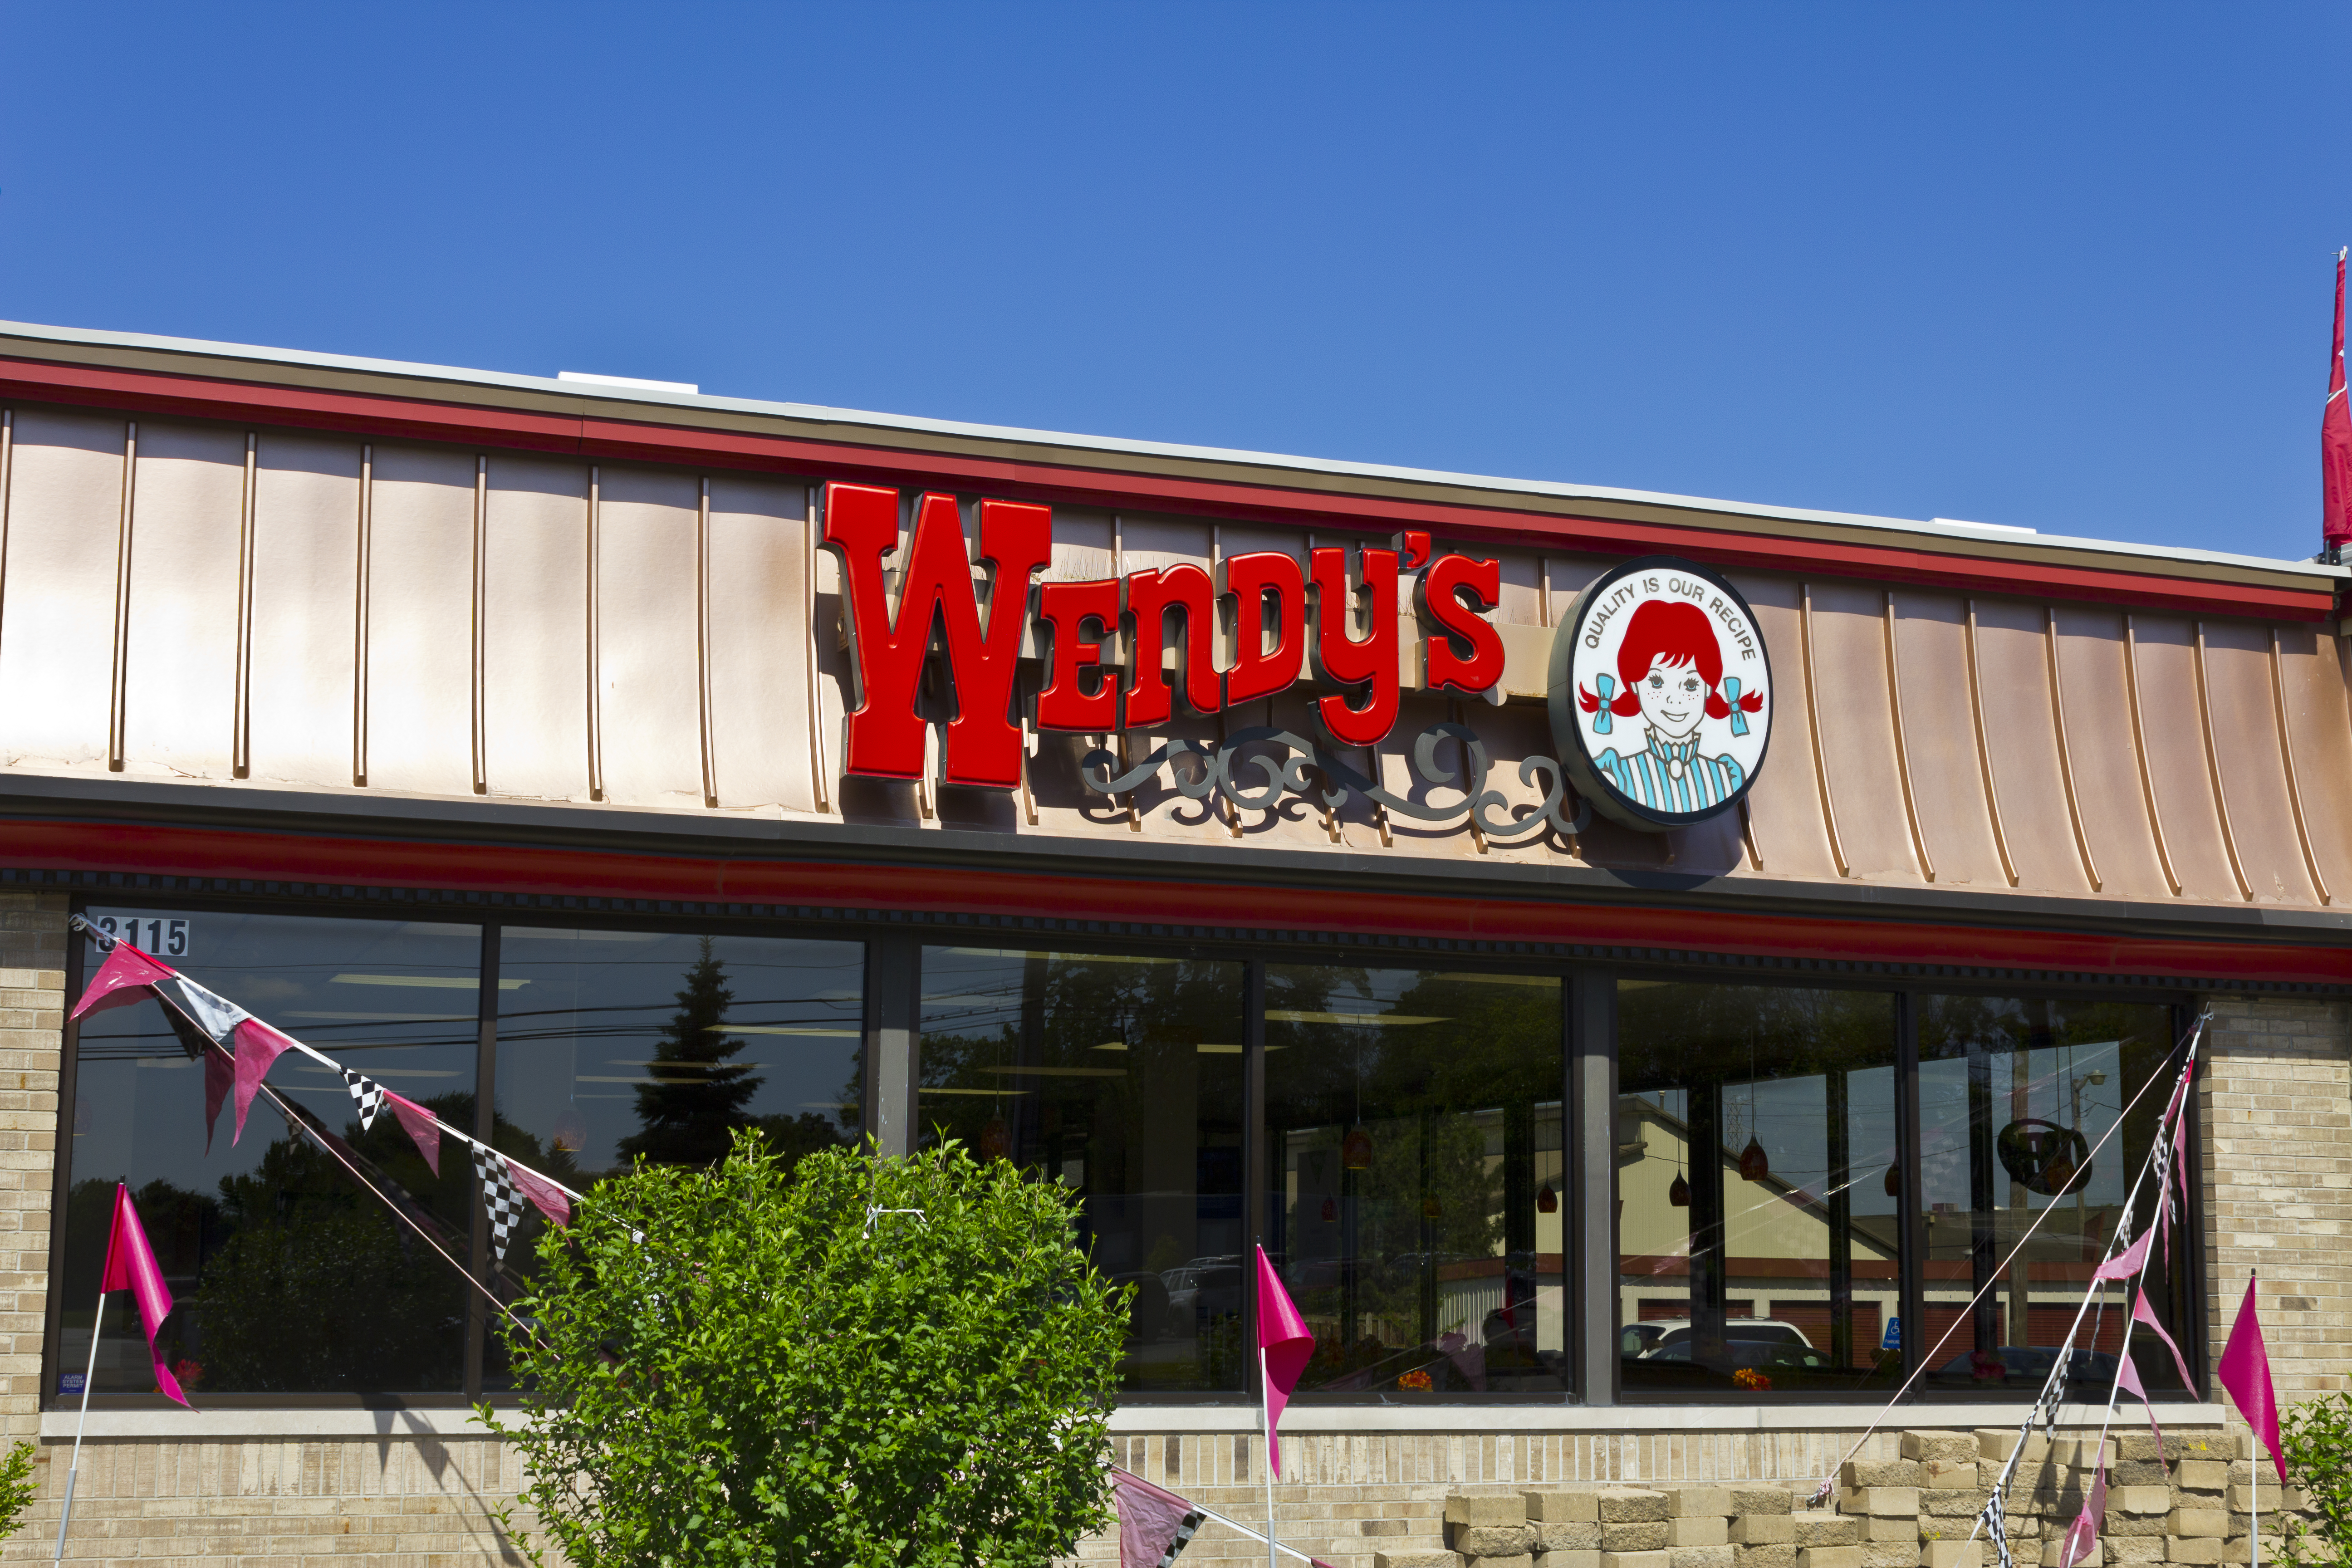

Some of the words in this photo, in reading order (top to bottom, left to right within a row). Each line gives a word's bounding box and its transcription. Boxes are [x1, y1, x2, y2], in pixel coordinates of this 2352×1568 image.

[1585, 583, 1635, 649] QUALITY
[1642, 577, 1660, 593] IS
[1668, 578, 1705, 602] OUR
[1709, 597, 1756, 661] RECIPE
[98, 917, 186, 955] 3115
